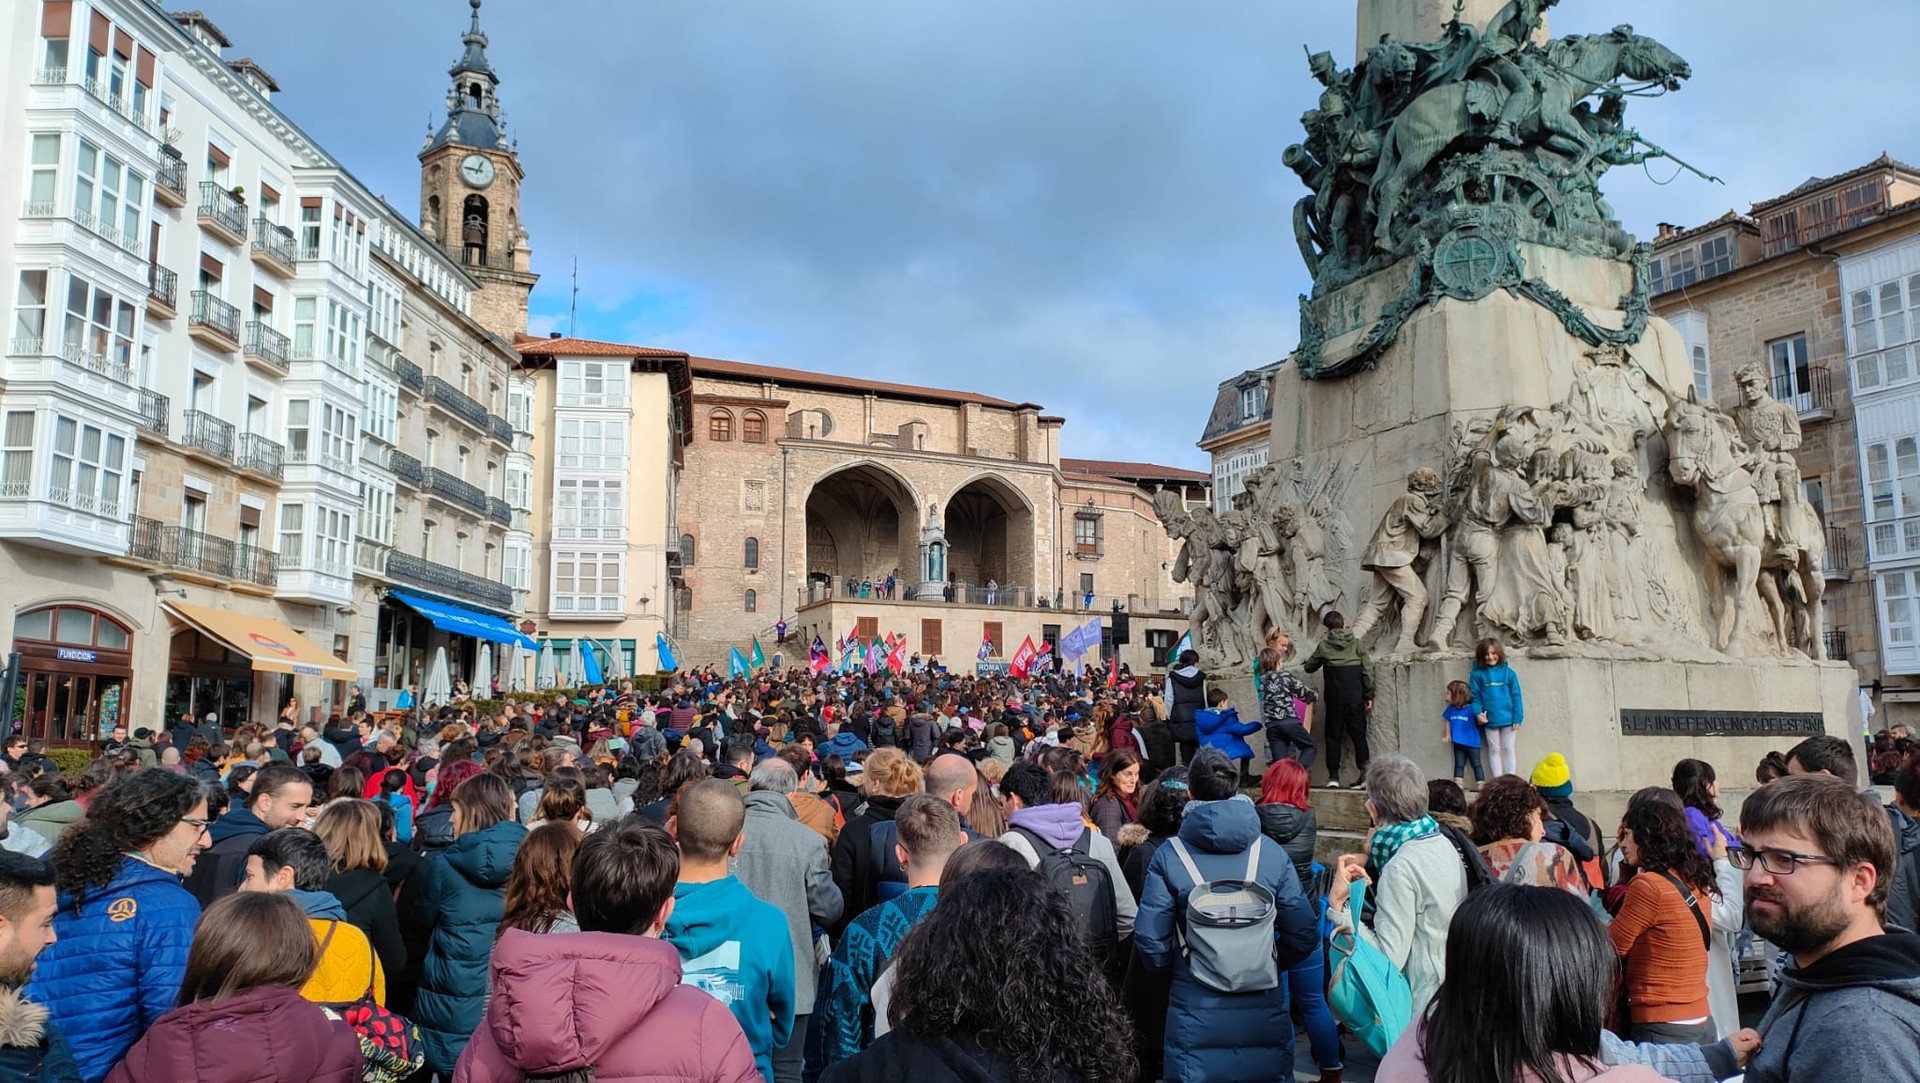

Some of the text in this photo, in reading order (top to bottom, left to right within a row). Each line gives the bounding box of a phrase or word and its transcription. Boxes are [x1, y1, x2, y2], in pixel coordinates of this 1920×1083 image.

[978, 664, 1000, 672] ROMA
[1621, 714, 1826, 732] A LA INDEPENDENCIA DE ESPAÑA
